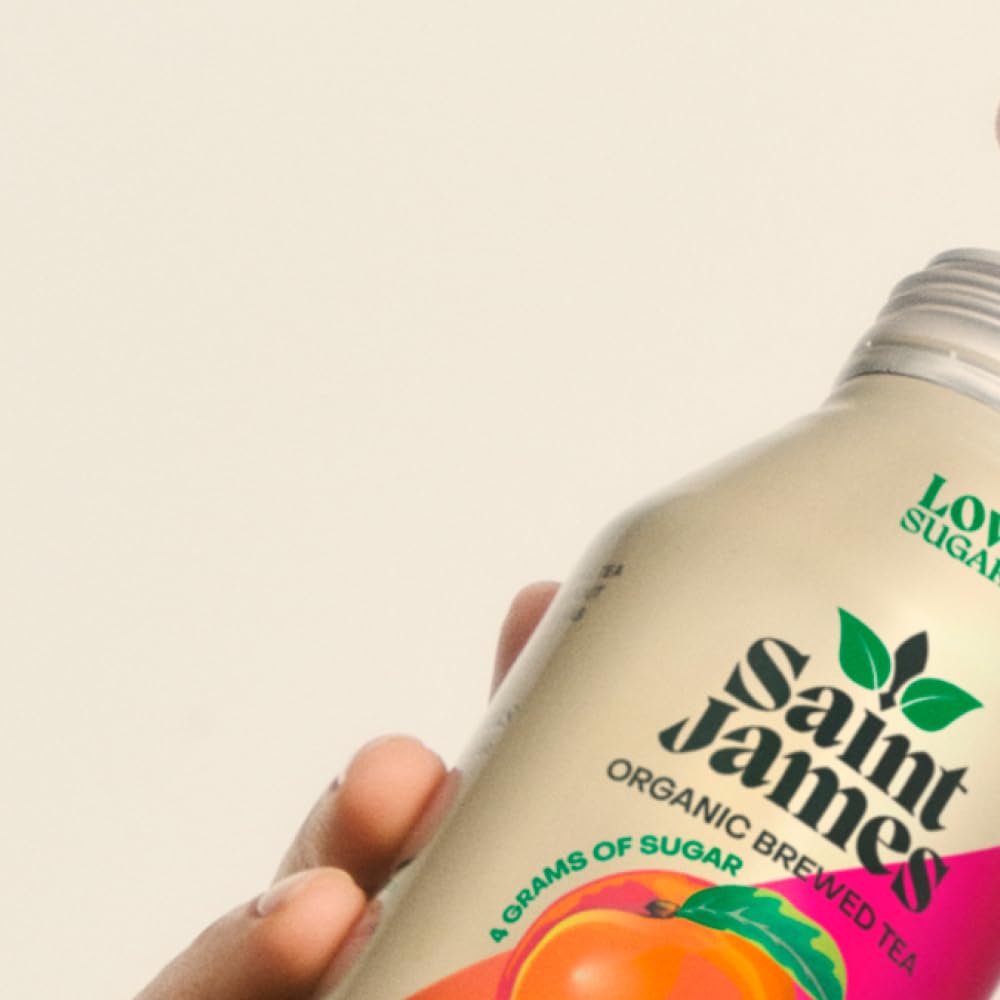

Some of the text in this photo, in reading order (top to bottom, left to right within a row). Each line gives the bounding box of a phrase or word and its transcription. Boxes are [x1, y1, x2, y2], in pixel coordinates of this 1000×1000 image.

[658, 696, 949, 913] James
[723, 637, 968, 832] Saint
[490, 834, 744, 943] 4 GRAMS OF SUGAR
[606, 758, 918, 977] ORGANIC BREWED TEA
